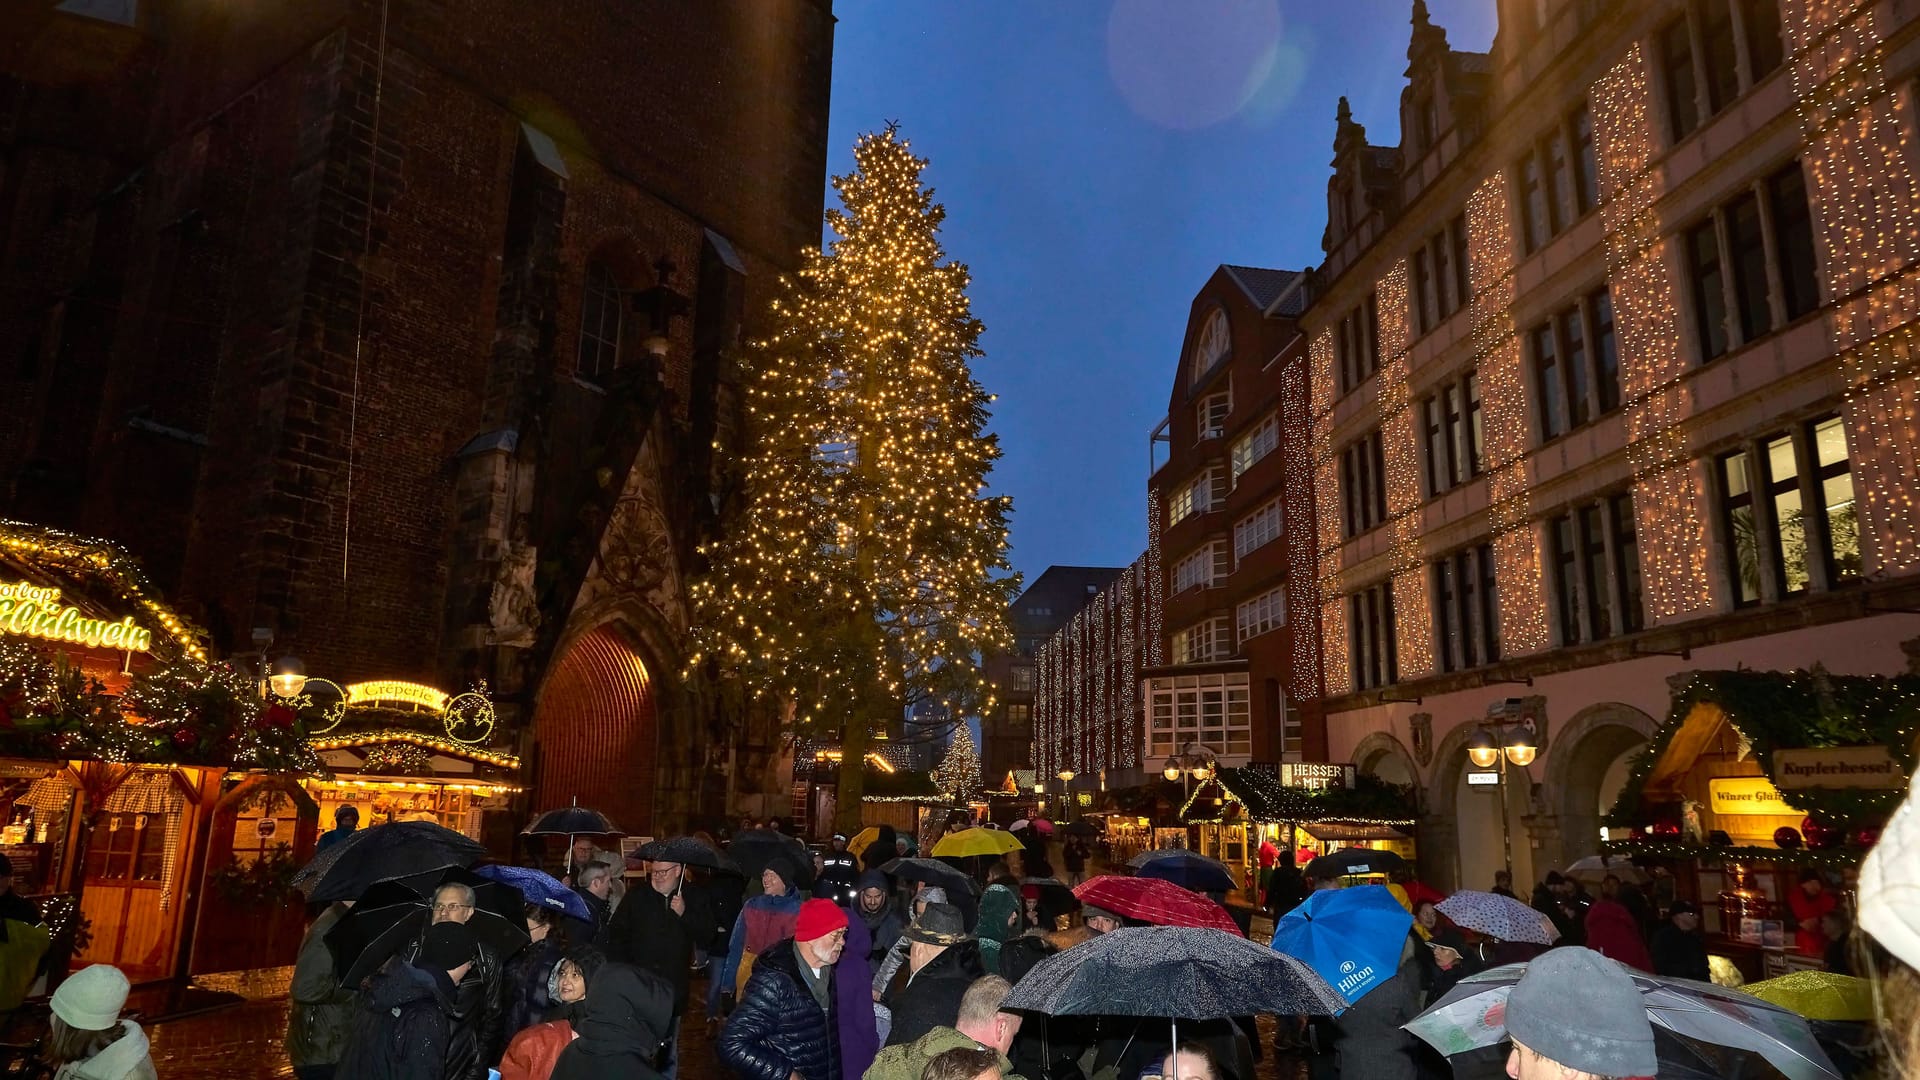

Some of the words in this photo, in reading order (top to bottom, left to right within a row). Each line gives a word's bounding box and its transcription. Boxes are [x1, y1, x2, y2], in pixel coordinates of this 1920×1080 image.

[1293, 763, 1342, 777] HEISSER
[1783, 760, 1892, 776] Kupferkessel
[1302, 777, 1330, 790] MET
[1716, 791, 1752, 801] Winzer
[1337, 966, 1374, 993] Hilton
